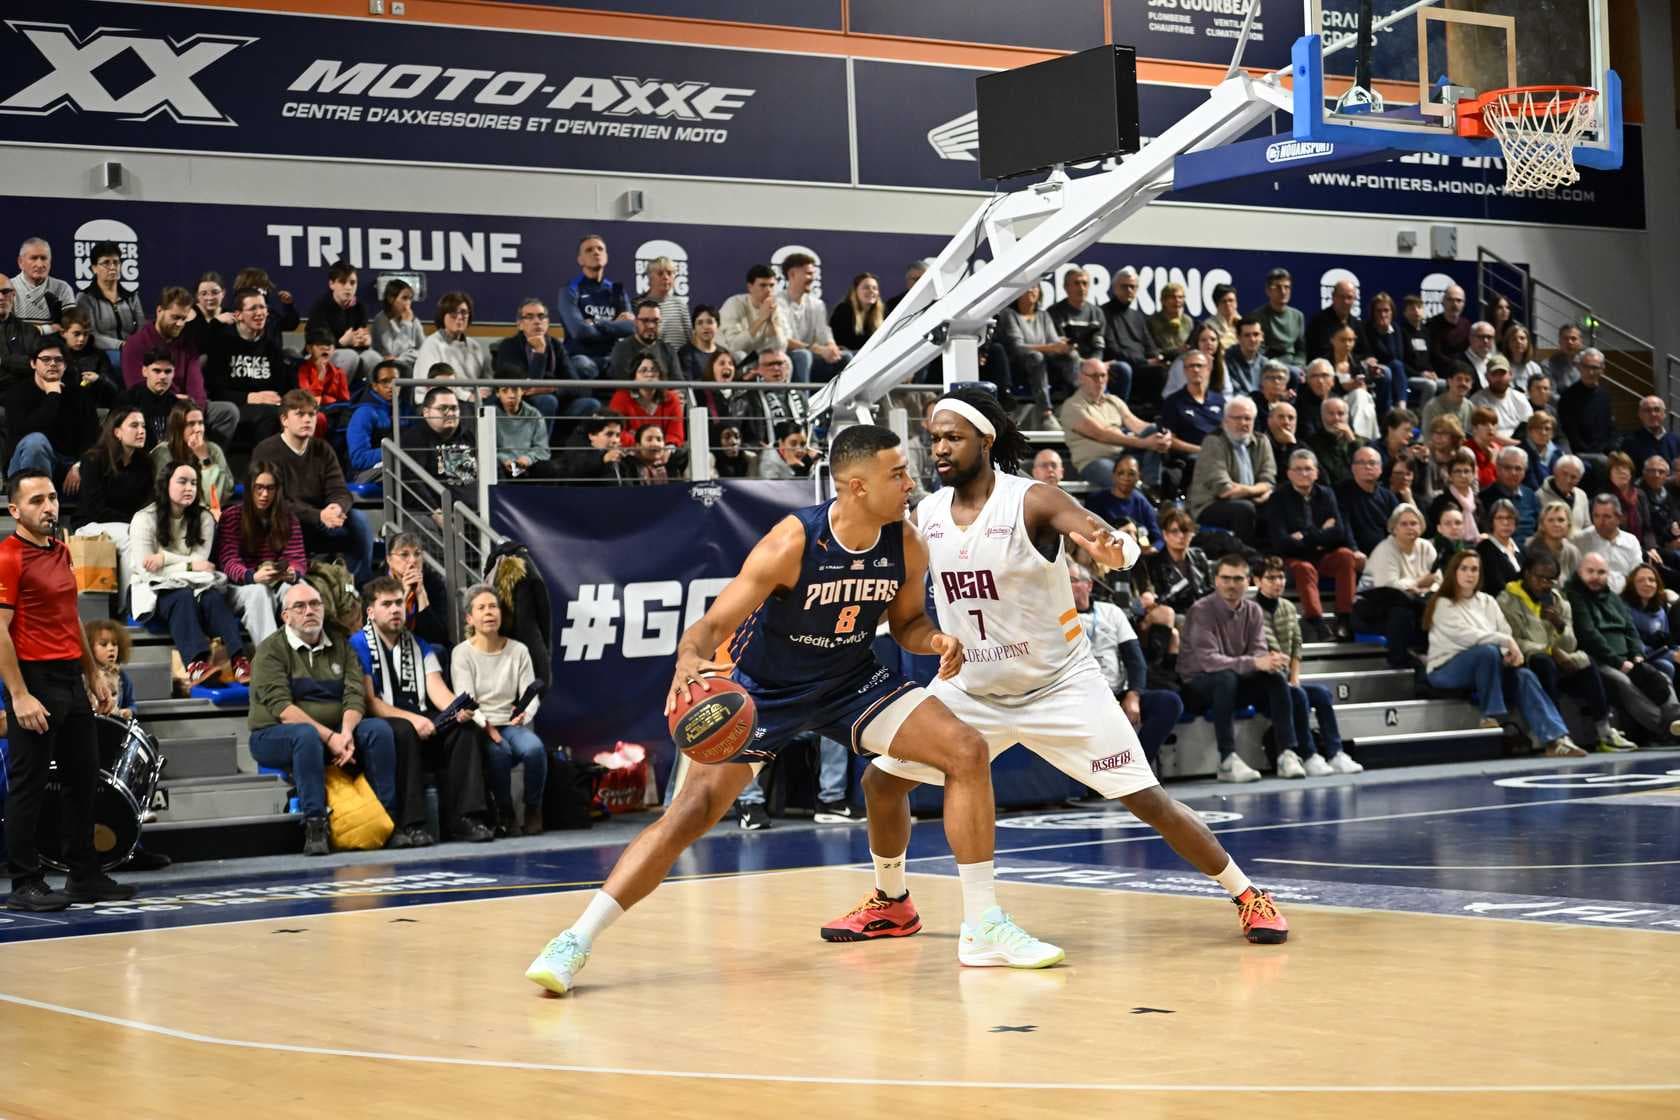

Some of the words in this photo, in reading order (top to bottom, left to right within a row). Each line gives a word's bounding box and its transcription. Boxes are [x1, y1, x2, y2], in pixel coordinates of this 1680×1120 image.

[287, 59, 757, 121] MOTO-AXXE
[281, 102, 363, 121] CENTRE
[366, 107, 522, 131] D'AXXESSOIRES
[525, 116, 552, 132] ET
[554, 118, 672, 140] D'ENTRETIEN
[674, 126, 728, 144] MOTO
[266, 224, 523, 274] TRIBUNE
[803, 578, 899, 610] POITIERS
[940, 569, 1000, 605] ASA
[834, 604, 861, 634] 8
[967, 609, 987, 641] 7
[1339, 684, 1349, 699] B
[1387, 709, 1399, 726] A
[151, 789, 168, 809] A
